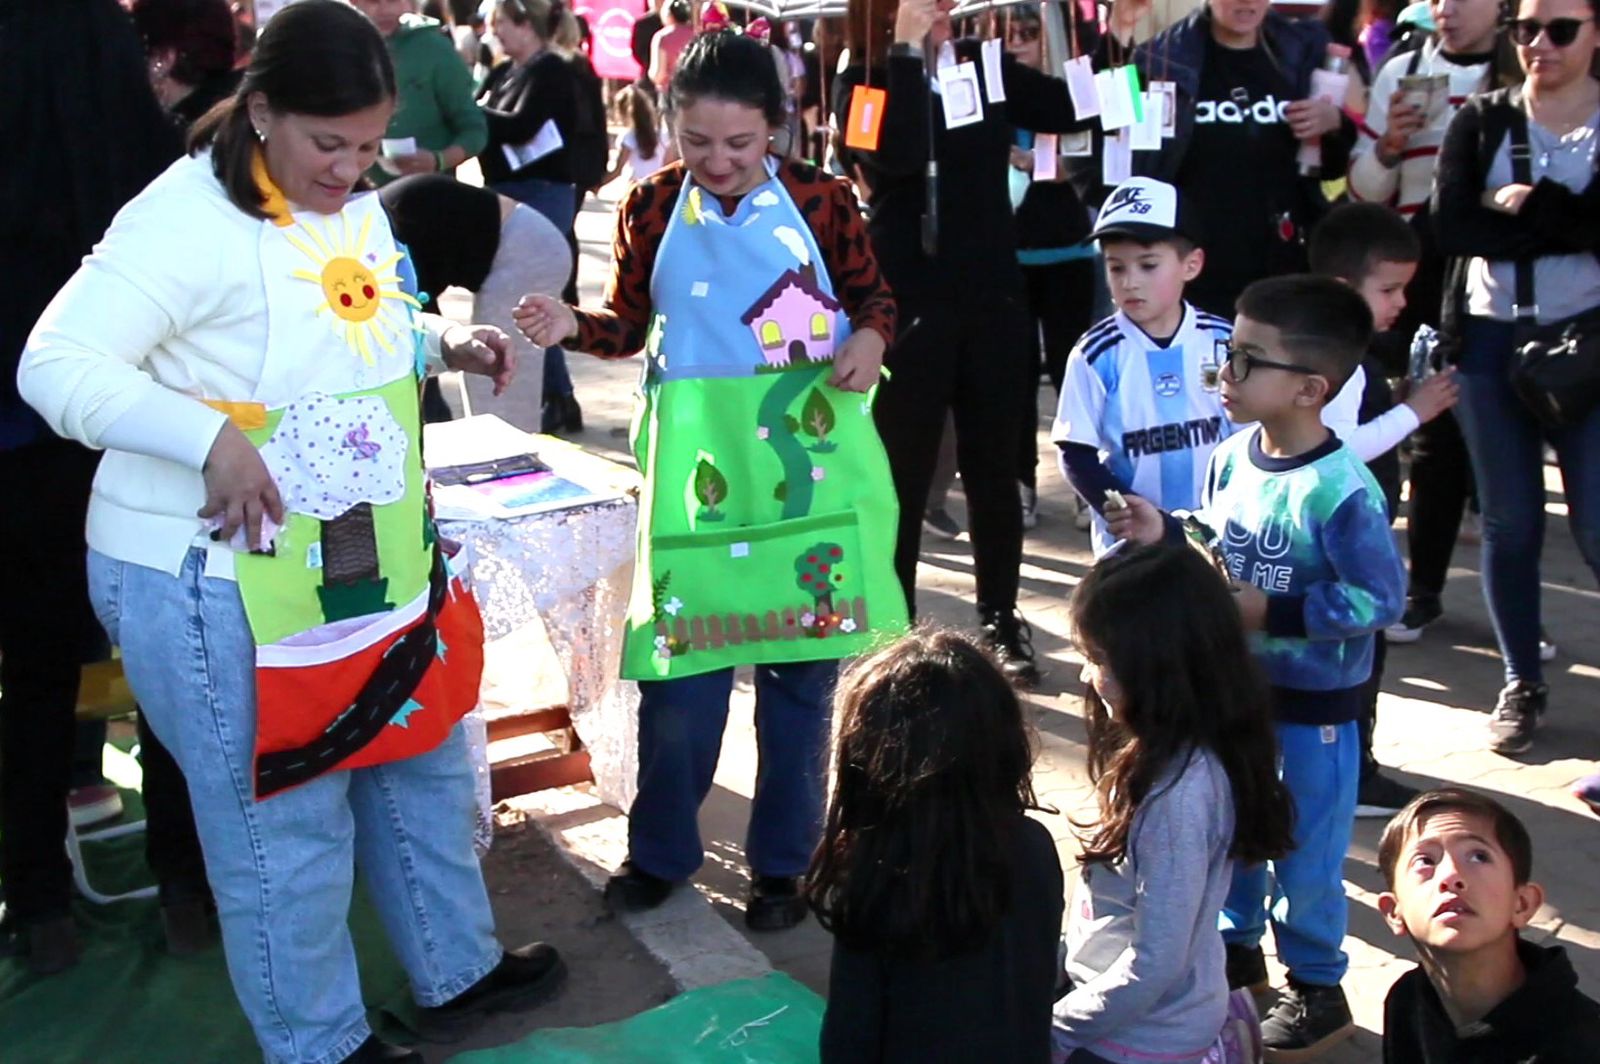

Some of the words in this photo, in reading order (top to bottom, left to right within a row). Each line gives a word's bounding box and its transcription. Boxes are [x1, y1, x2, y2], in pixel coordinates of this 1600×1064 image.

[1128, 201, 1152, 215] SB
[1121, 416, 1222, 459] ARGENTIN
[1251, 561, 1293, 592] ME
